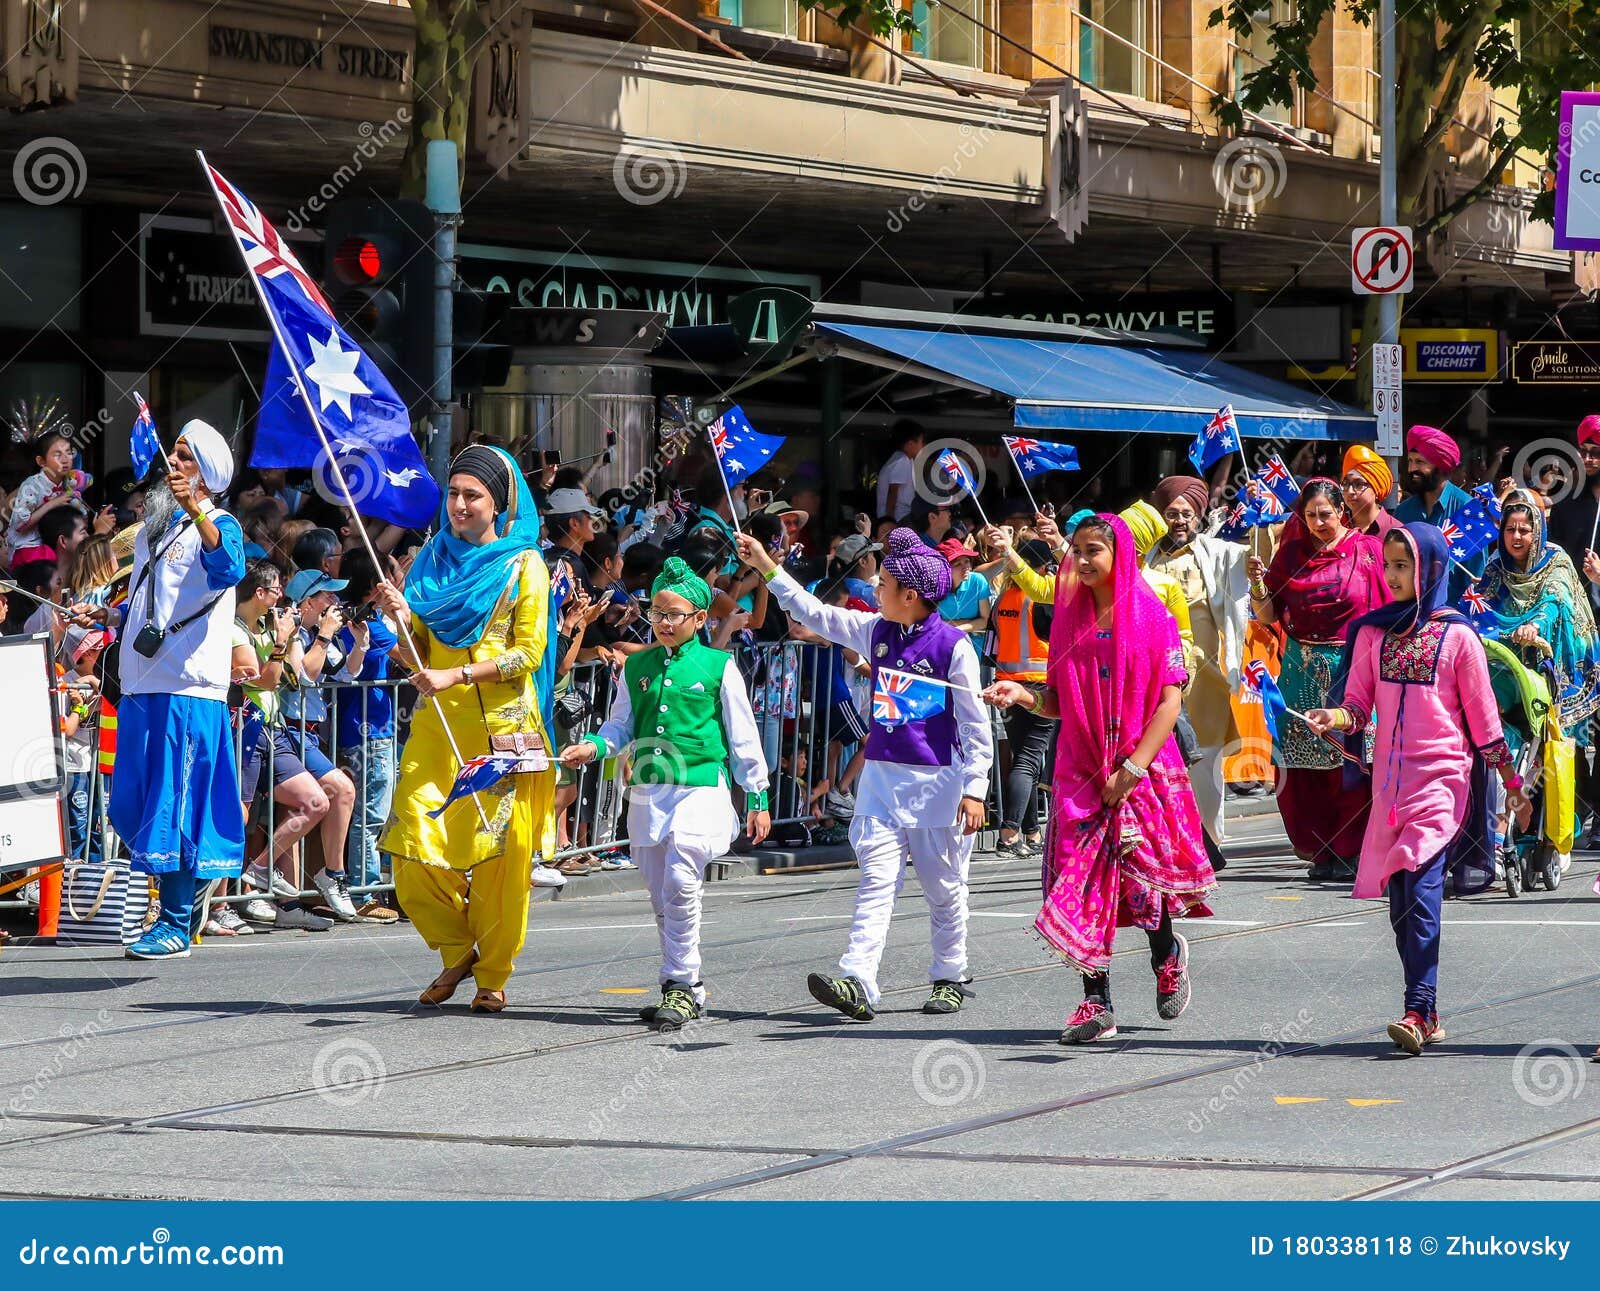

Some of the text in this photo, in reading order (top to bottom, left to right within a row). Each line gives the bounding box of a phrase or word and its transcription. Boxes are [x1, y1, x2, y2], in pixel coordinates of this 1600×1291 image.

[208, 26, 408, 84] SWANSTON STREET
[186, 273, 256, 305] TRAVEL
[1422, 345, 1481, 356] DISCOUNT
[1427, 358, 1476, 368] CHEMIST
[1531, 345, 1568, 380] Smile
